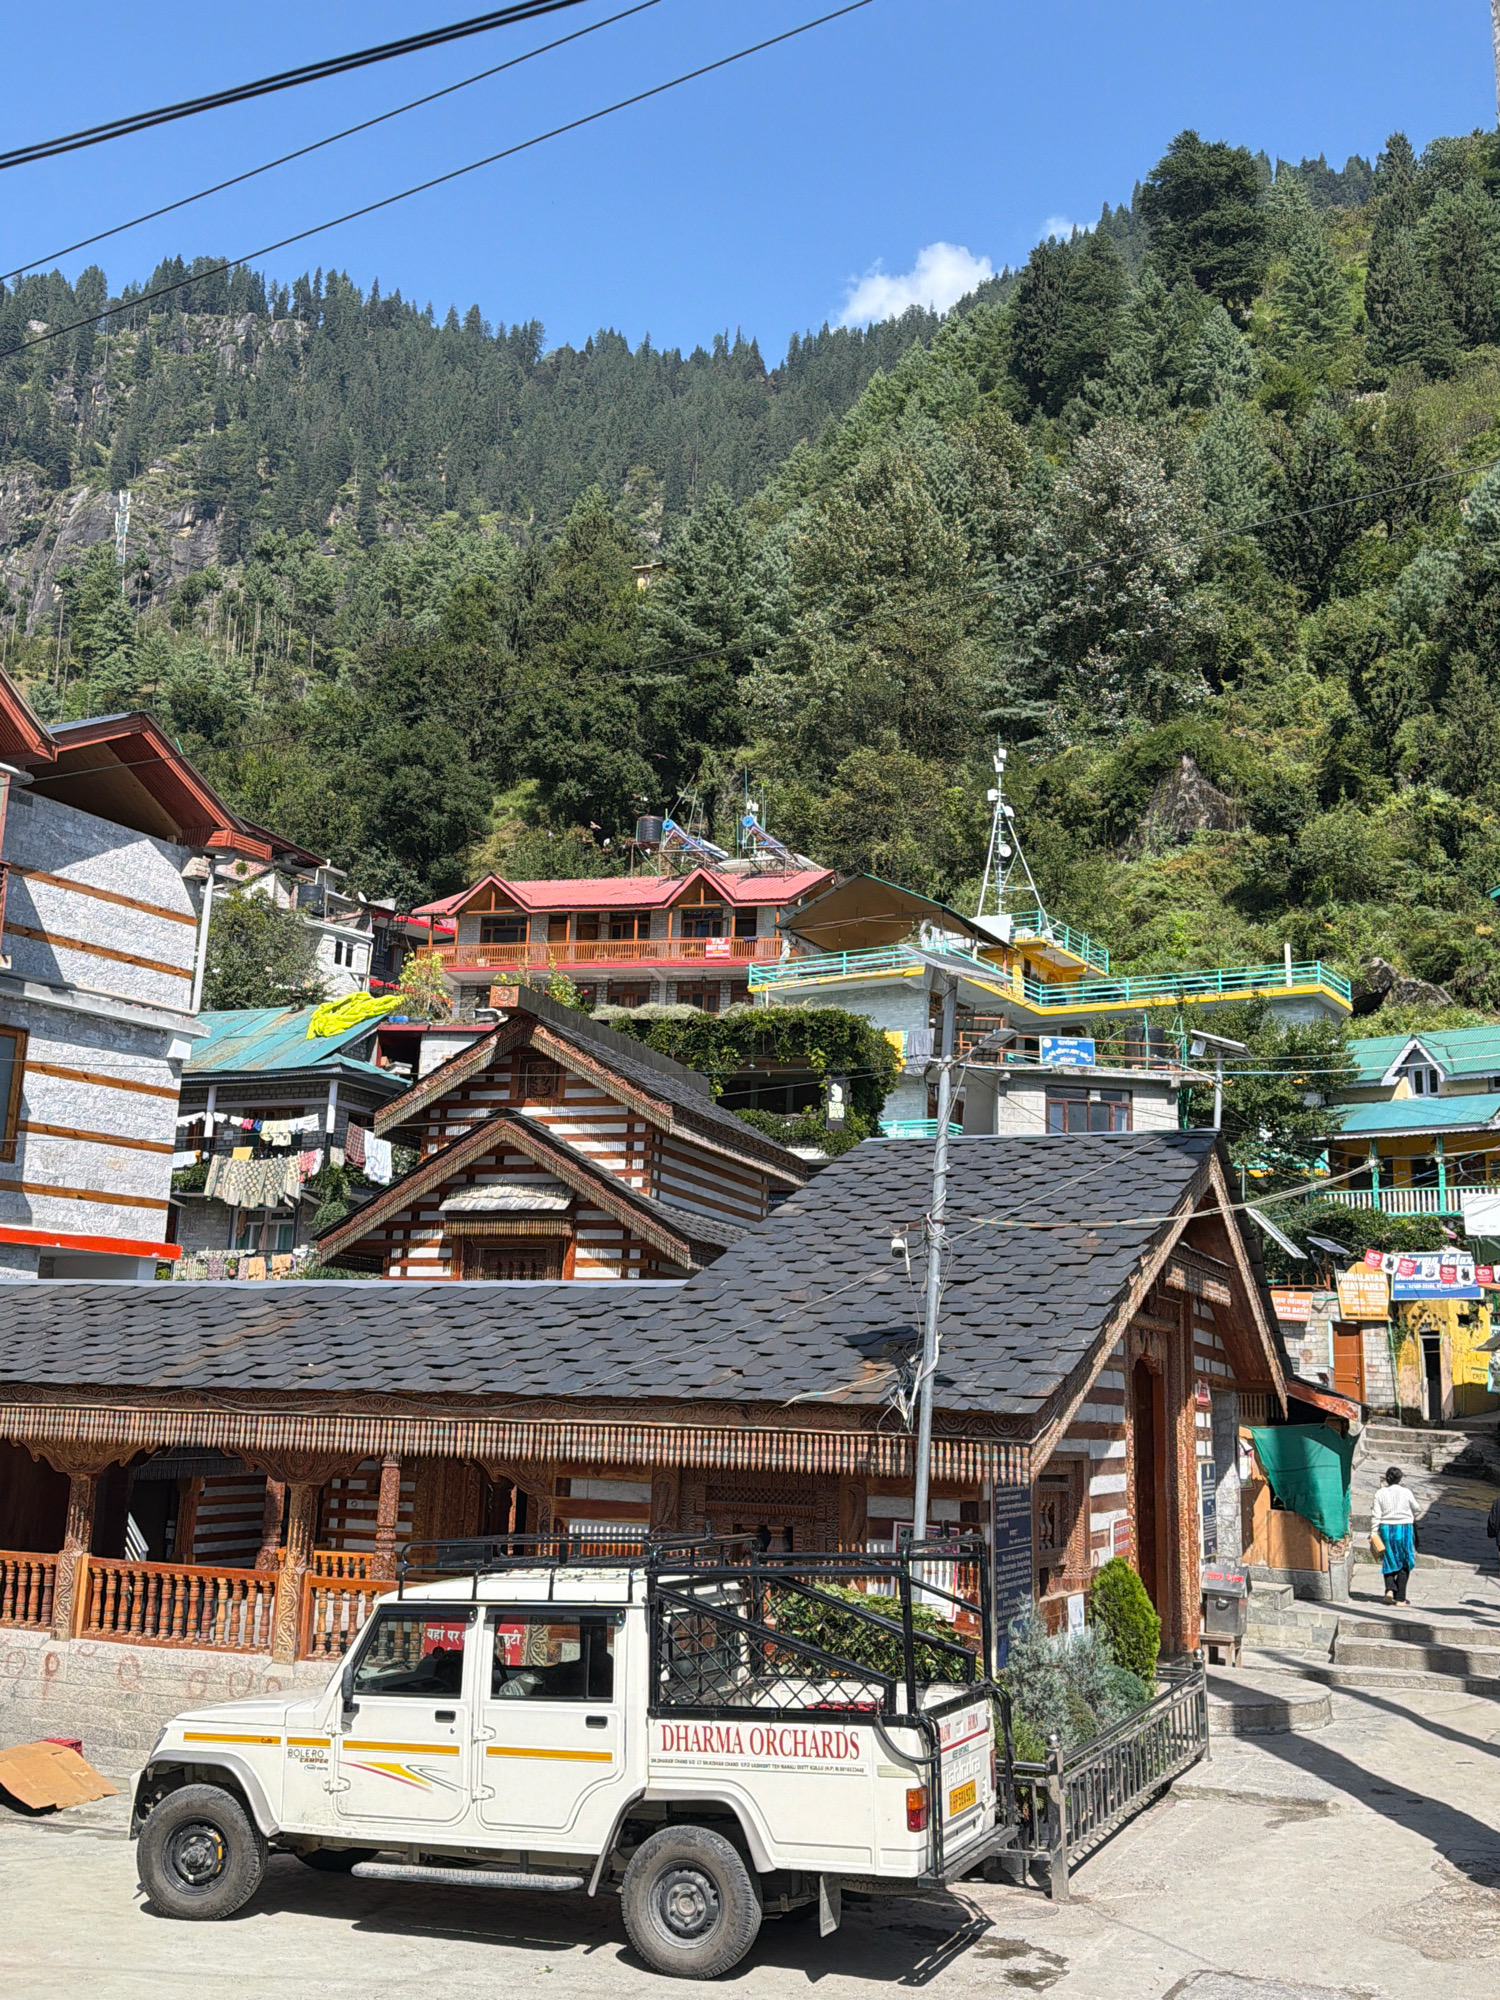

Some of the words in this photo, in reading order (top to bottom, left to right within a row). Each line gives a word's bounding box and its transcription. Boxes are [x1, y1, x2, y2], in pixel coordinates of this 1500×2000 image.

[1338, 1272, 1387, 1282] HIMALAYAN
[1340, 1282, 1386, 1291] WAYFARER
[447, 1630, 460, 1644] पर
[661, 1724, 745, 1755] DHARMA
[749, 1727, 860, 1761] ORCHARDS
[287, 1748, 325, 1758] BOLERO
